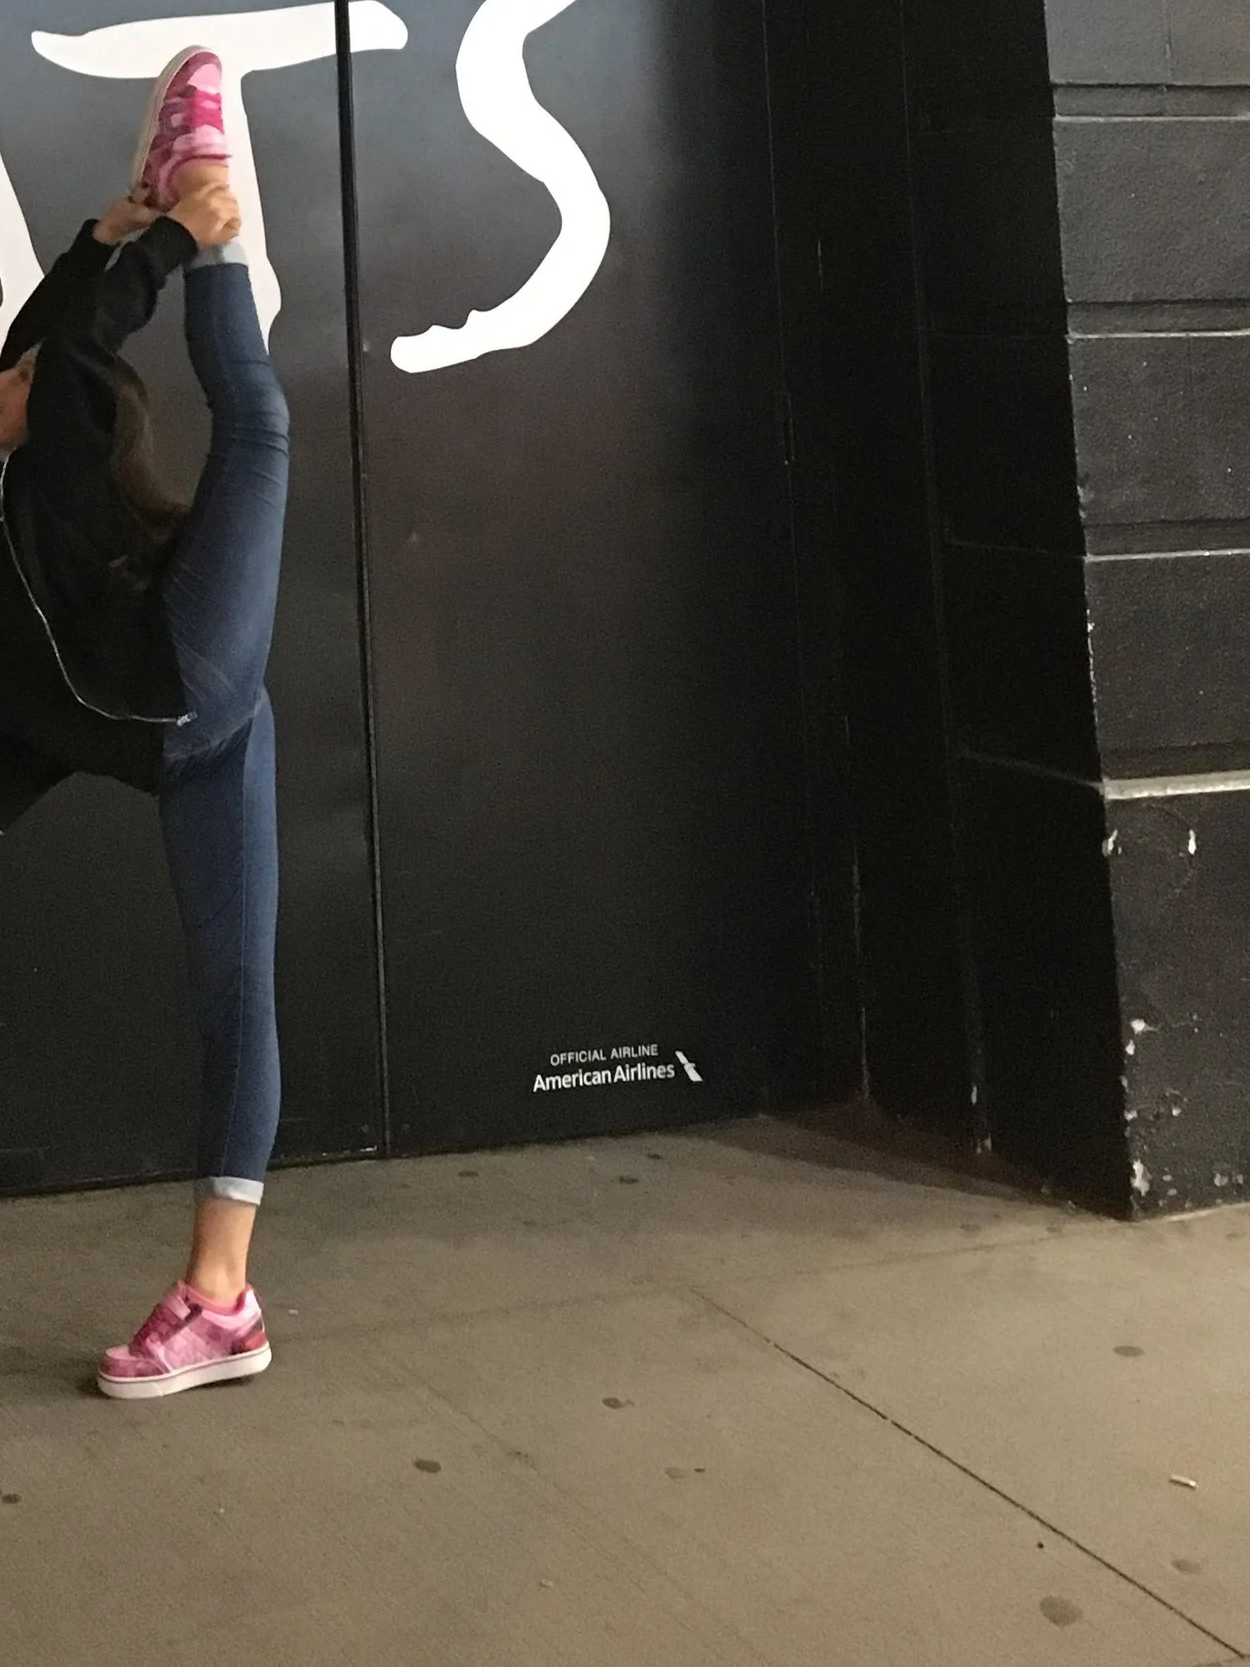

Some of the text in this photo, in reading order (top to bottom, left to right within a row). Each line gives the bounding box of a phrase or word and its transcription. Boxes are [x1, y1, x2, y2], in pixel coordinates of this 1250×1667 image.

[550, 1043, 659, 1067] OFFICIAL AIRLINE
[533, 1062, 676, 1093] American Airlines
